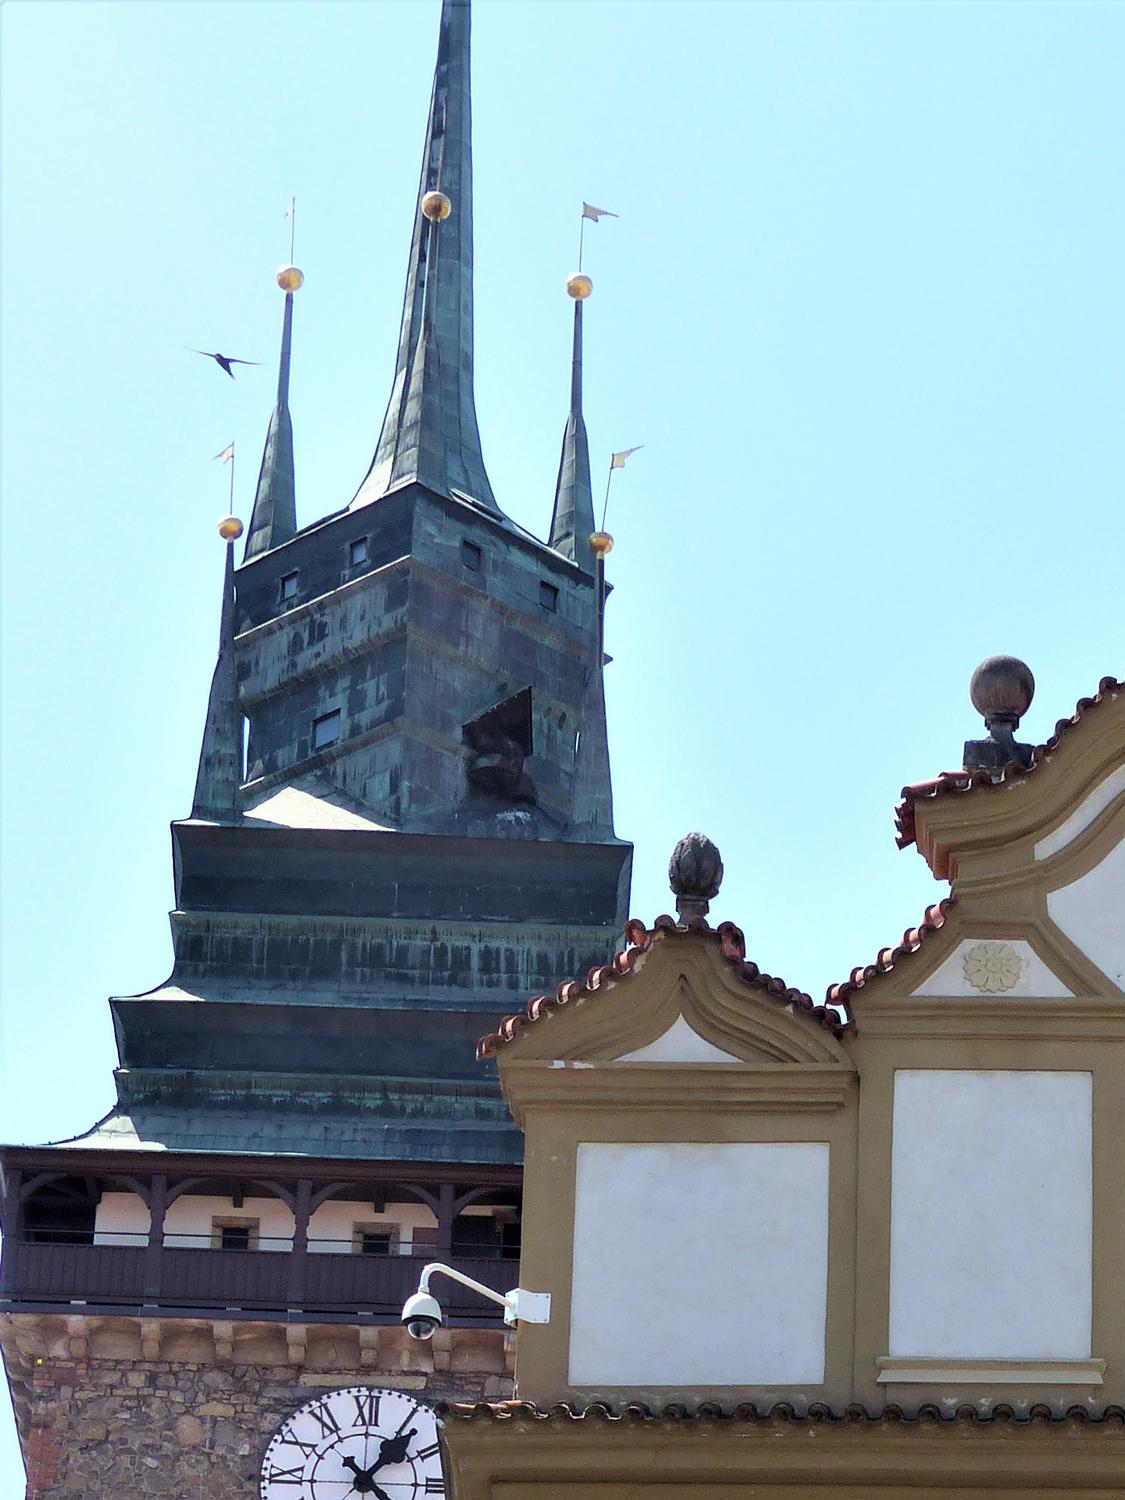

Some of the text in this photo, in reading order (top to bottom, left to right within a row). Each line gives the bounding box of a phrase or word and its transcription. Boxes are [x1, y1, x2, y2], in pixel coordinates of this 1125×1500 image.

[308, 1402, 341, 1439] XI
[352, 1395, 381, 1427] XII
[279, 1428, 318, 1460] X
[269, 1464, 305, 1486] IX
